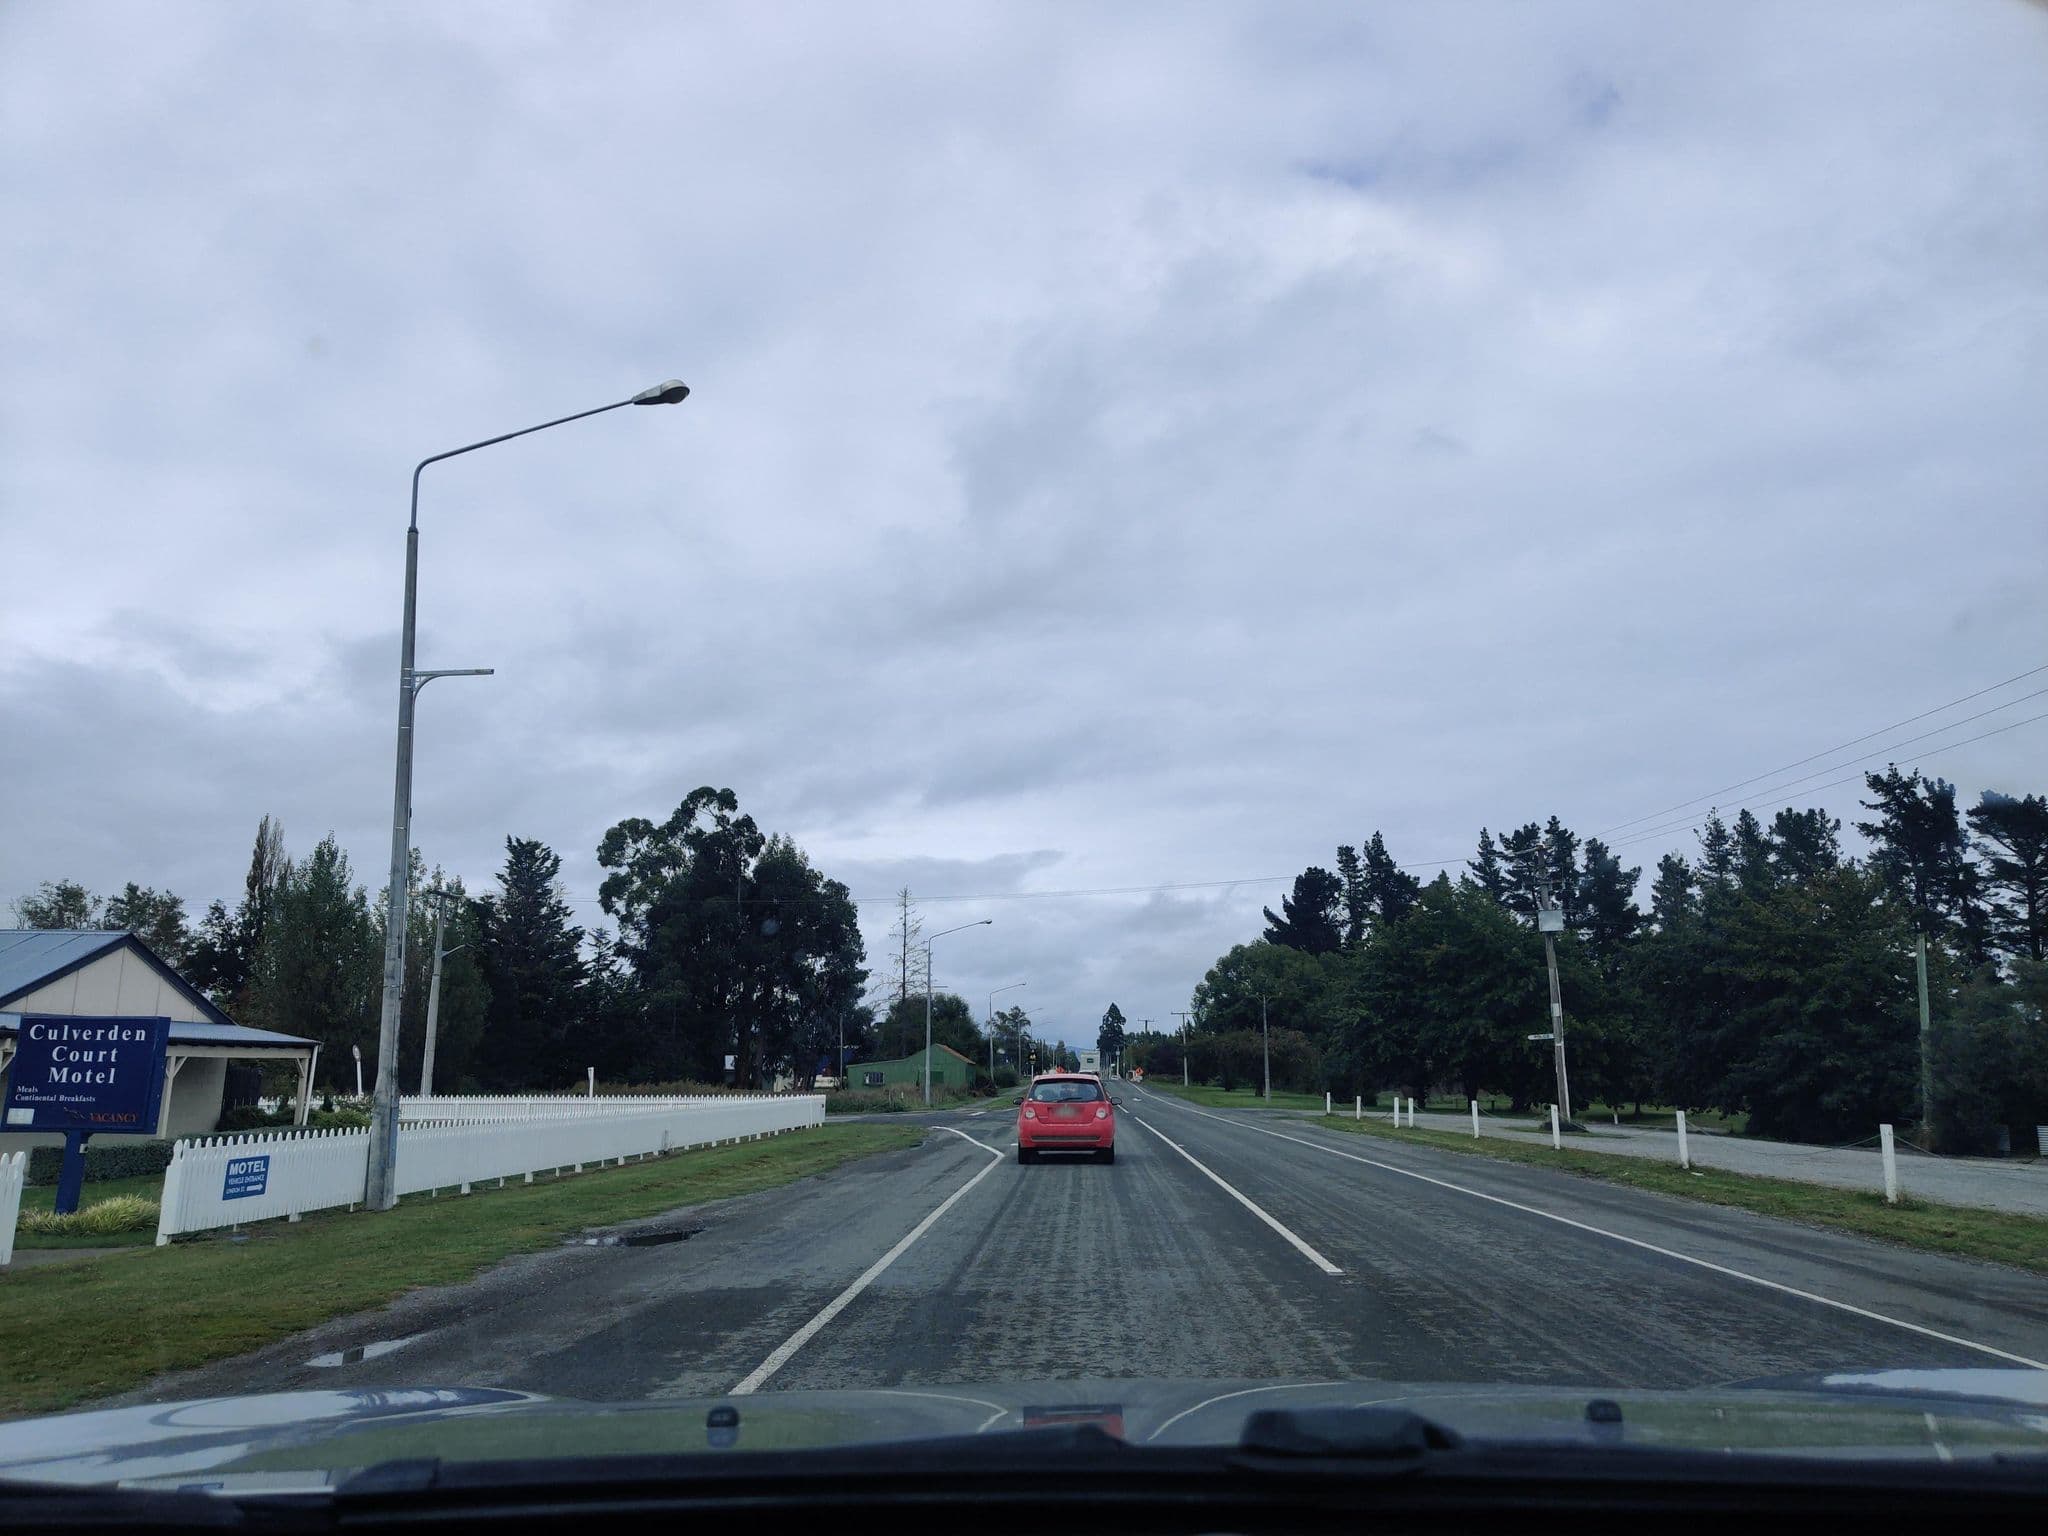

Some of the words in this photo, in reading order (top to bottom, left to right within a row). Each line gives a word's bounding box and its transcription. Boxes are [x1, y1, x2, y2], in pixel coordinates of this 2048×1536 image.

[30, 1024, 147, 1041] Culverden
[52, 1046, 118, 1062] Court
[48, 1067, 116, 1084] Motel
[15, 1094, 57, 1102] Continental
[90, 1112, 138, 1123] VACANCY
[229, 1160, 266, 1176] MOTEL
